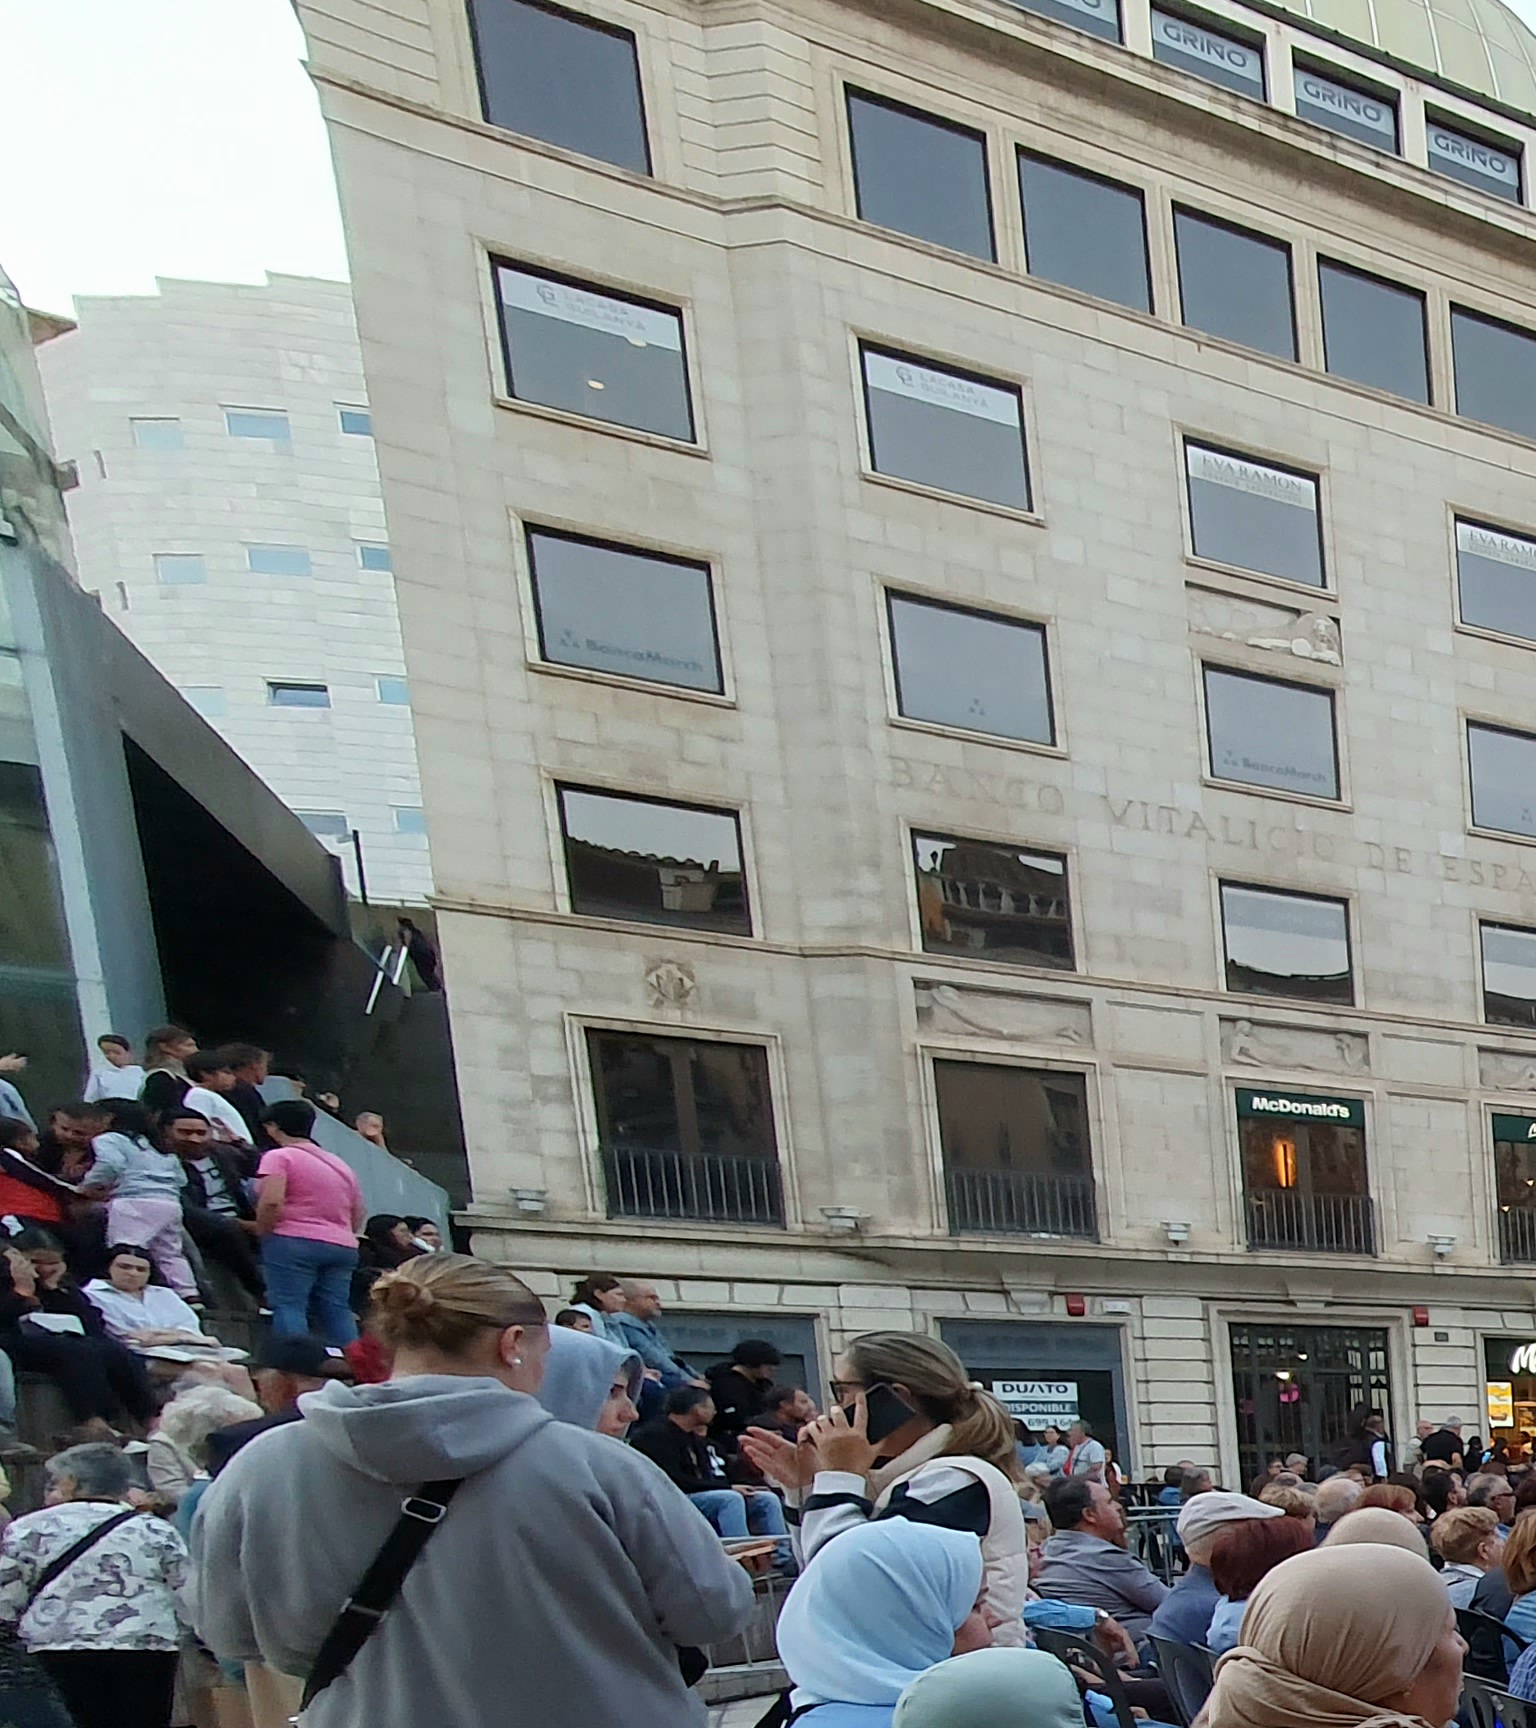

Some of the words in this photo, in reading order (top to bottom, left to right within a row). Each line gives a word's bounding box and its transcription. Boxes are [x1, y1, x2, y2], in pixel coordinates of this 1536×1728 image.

[1103, 796, 1336, 860] VITALICIO
[1365, 841, 1412, 874] DE
[1251, 1096, 1350, 1119] McDonald's
